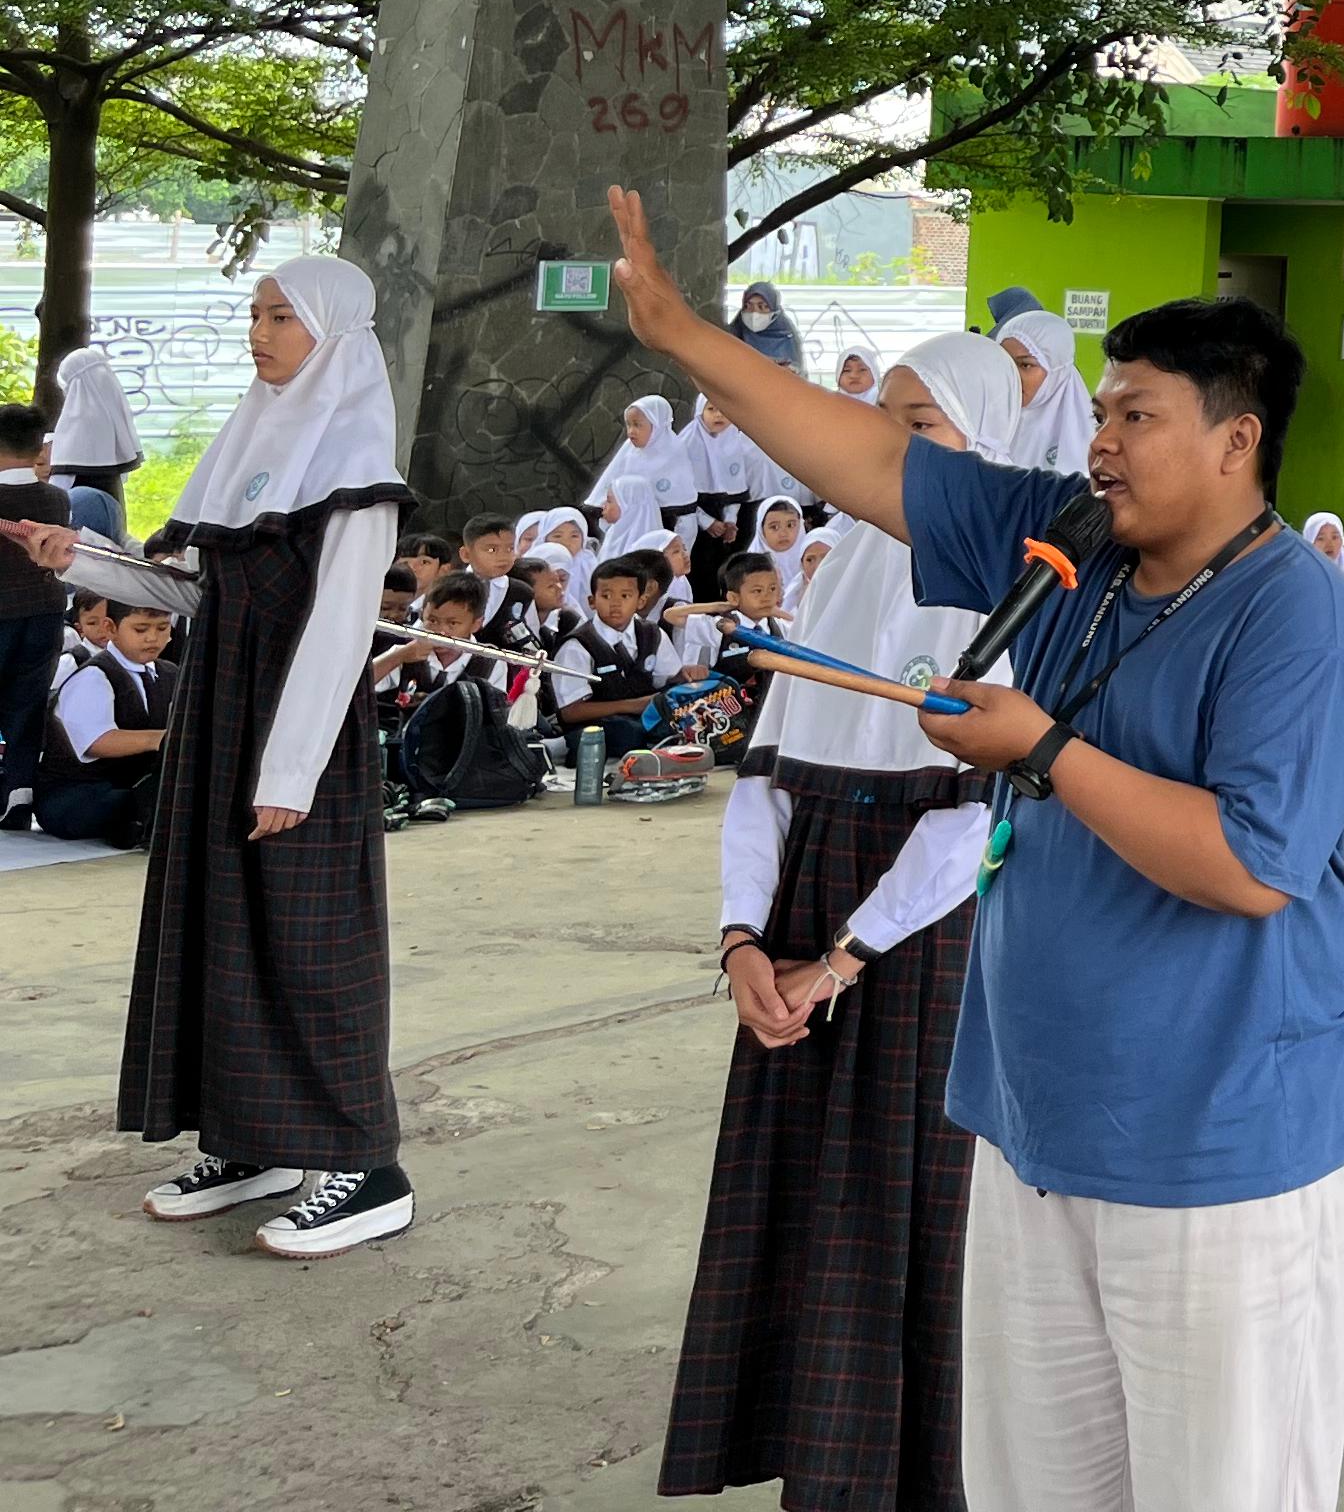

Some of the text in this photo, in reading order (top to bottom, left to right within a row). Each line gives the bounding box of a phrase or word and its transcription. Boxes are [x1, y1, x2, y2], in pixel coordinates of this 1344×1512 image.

[588, 93, 690, 135] 269
[1067, 306, 1106, 317] SAMPAH
[1071, 294, 1103, 304] BUANG
[1163, 568, 1214, 616] BANDUNG
[1081, 591, 1115, 648] BANDUNG
